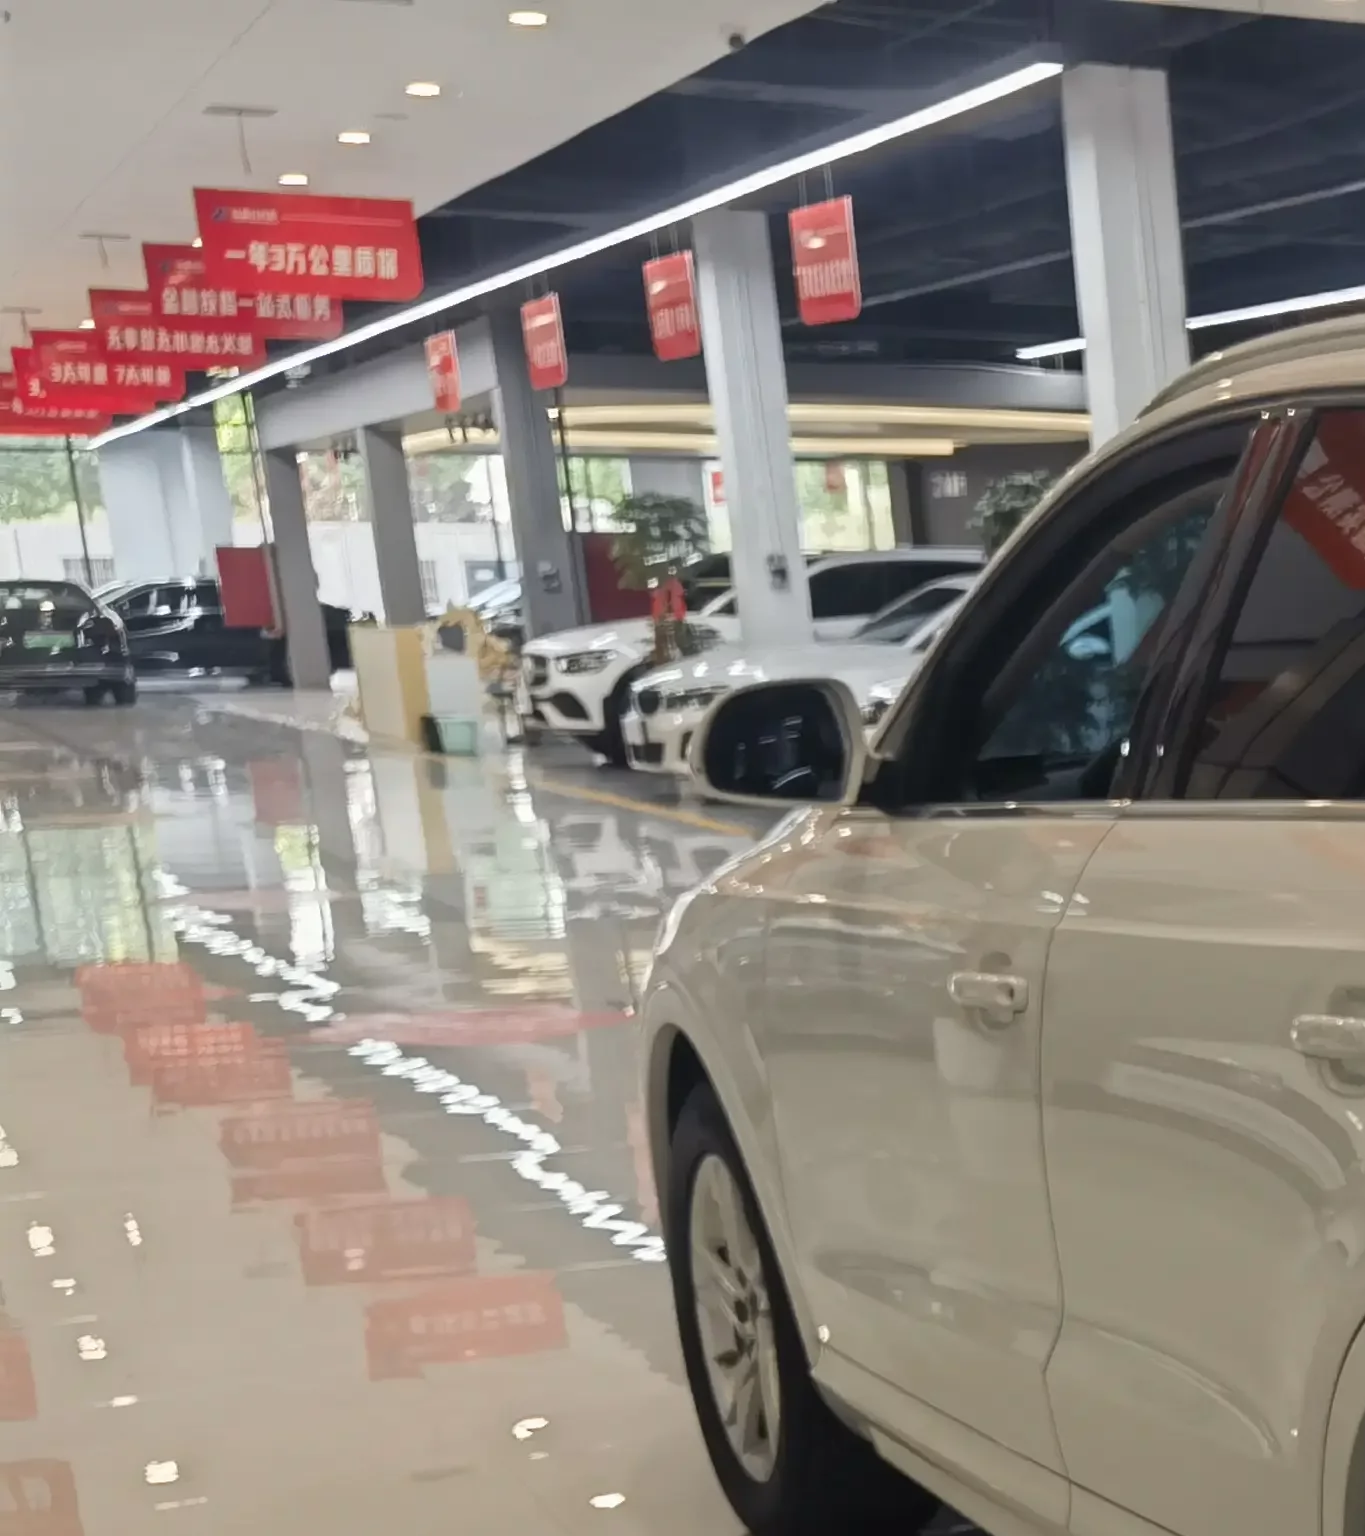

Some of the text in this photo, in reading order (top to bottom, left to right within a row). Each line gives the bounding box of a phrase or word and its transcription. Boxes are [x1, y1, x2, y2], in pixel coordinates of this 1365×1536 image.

[225, 240, 398, 280] 一年3万公里质保
